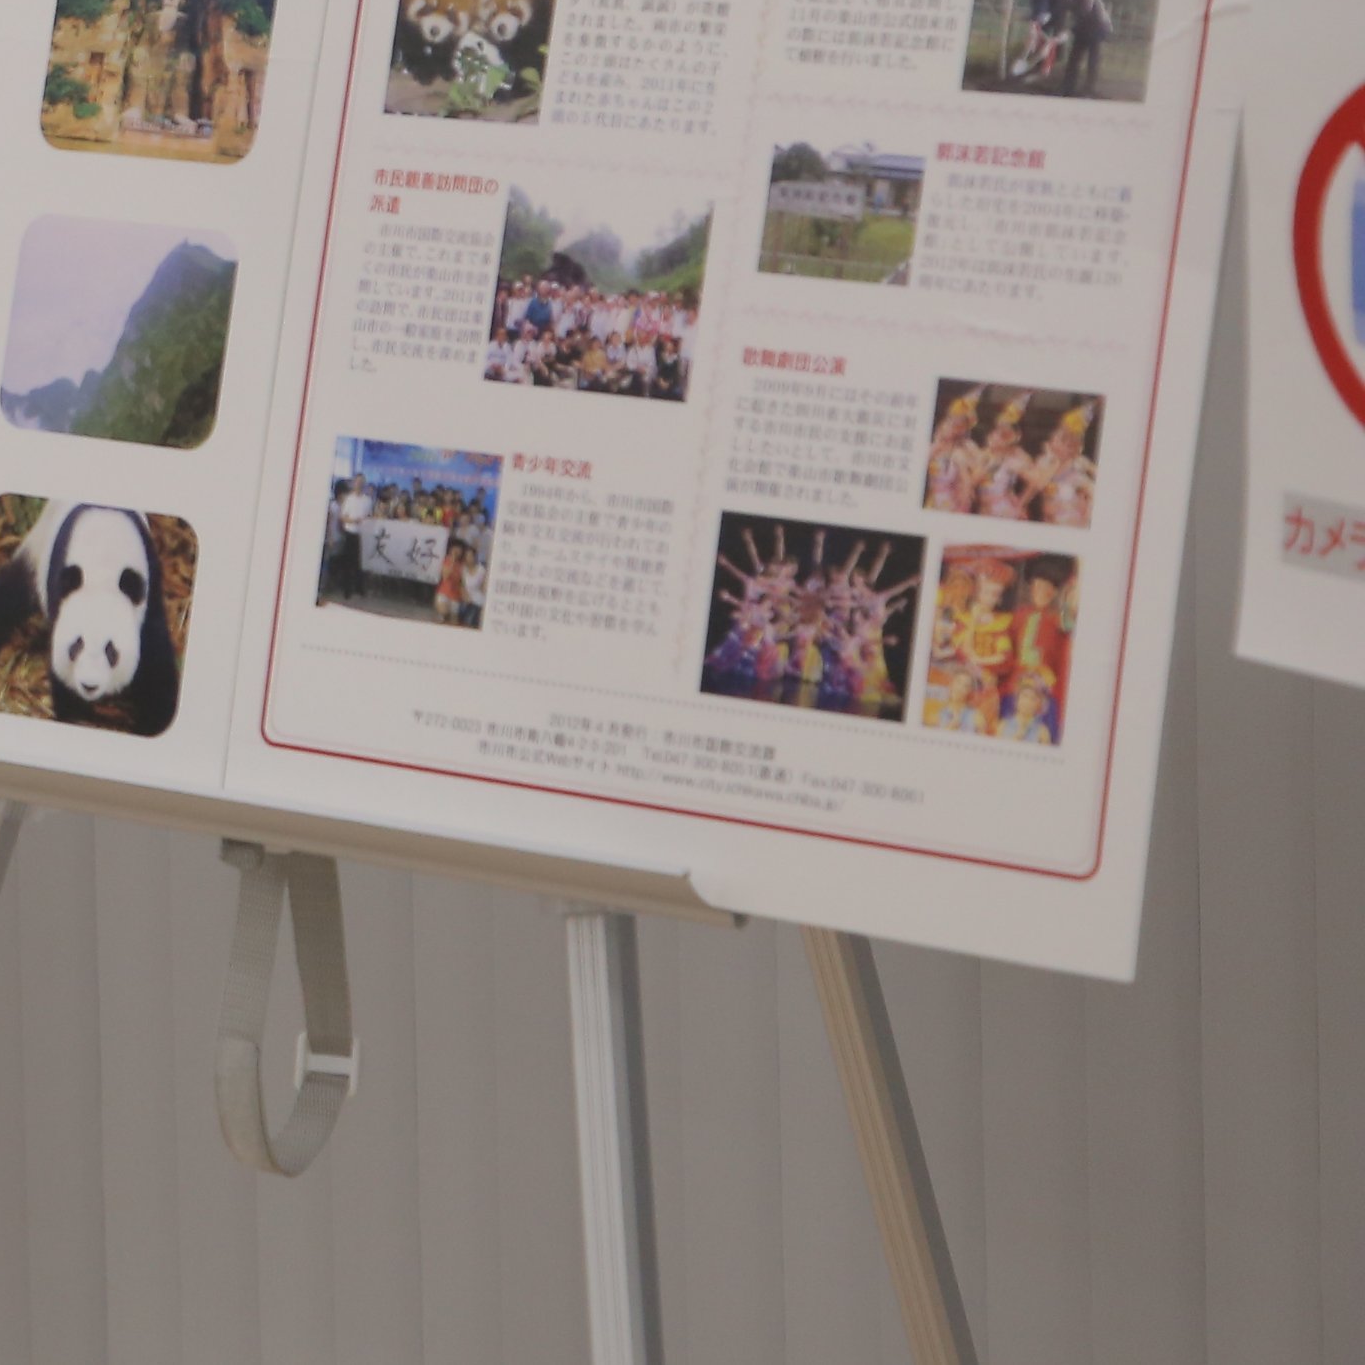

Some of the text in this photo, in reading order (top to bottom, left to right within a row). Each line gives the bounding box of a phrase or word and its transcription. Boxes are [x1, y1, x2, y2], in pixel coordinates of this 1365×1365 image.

[512, 453, 593, 482] 青少年交流
